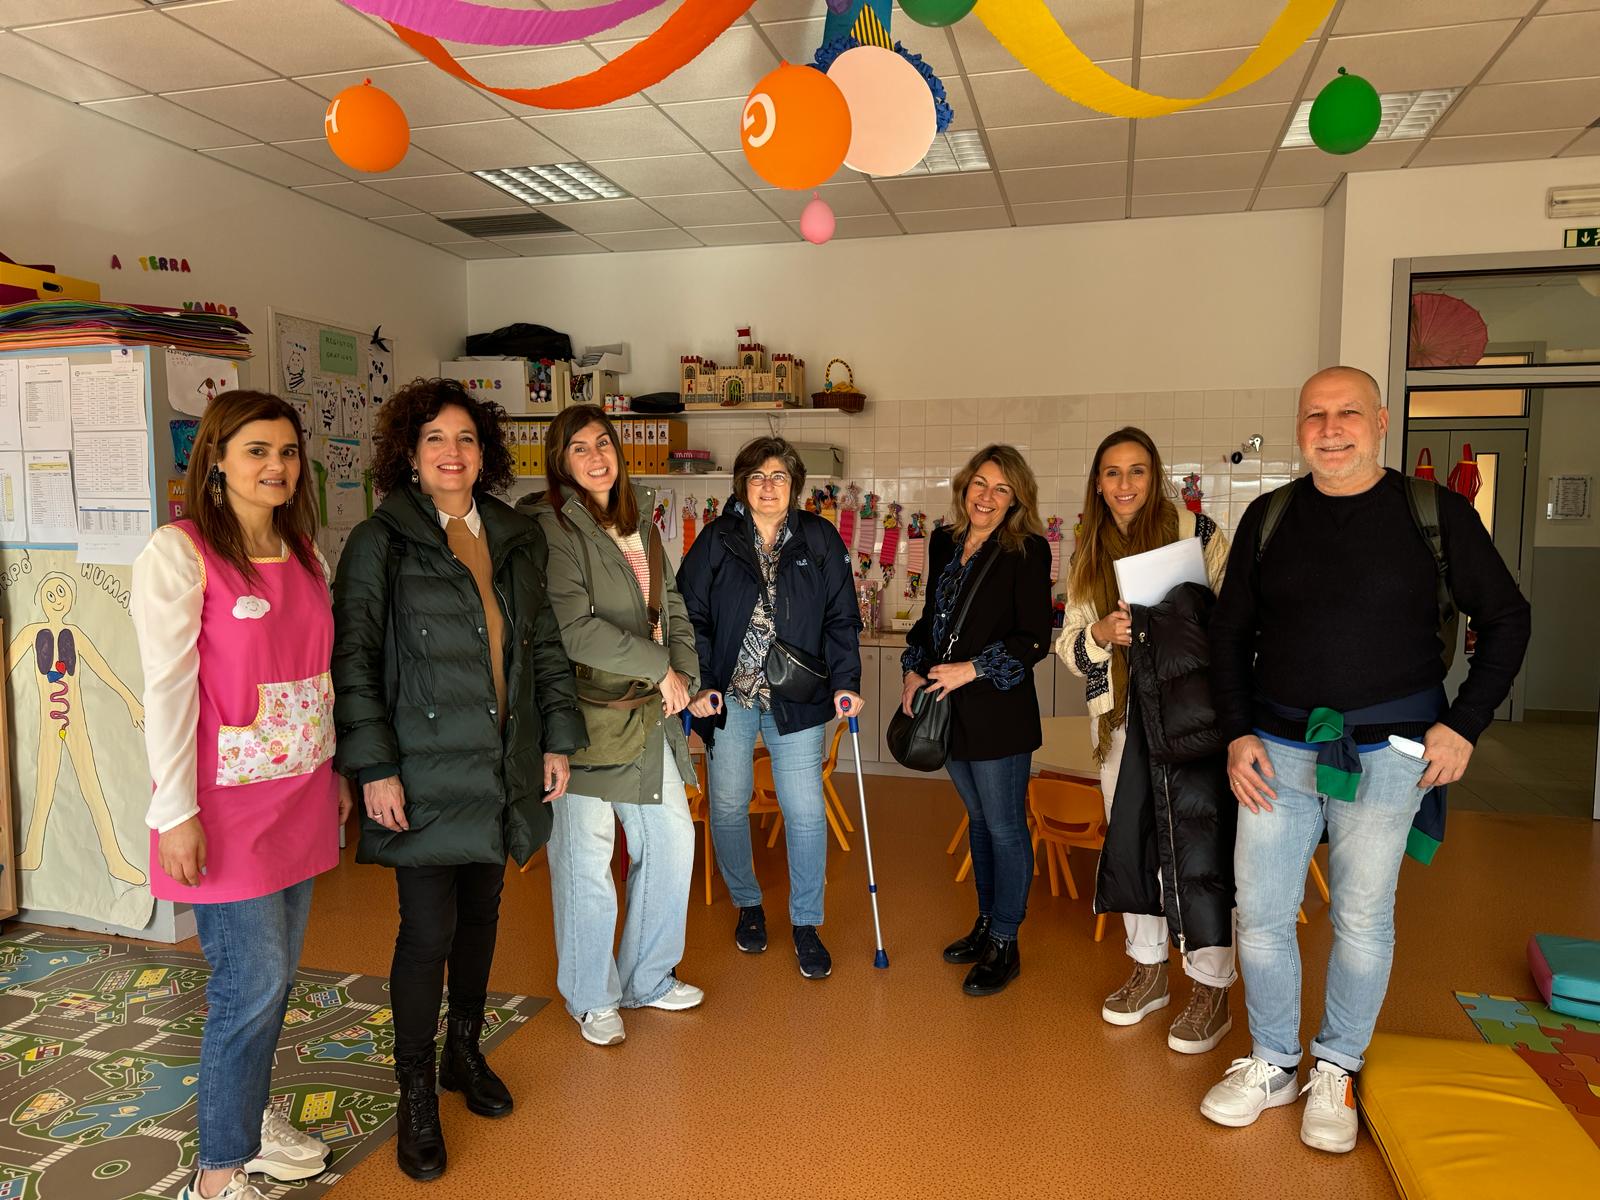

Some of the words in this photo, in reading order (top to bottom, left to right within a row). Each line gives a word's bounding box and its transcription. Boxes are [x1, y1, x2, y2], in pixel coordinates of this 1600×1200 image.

[111, 254, 122, 270] A
[138, 255, 191, 273] TERRA
[183, 301, 238, 319] VAMOS
[462, 378, 503, 391] ASTAS
[0, 557, 33, 591] RPO
[80, 562, 133, 617] HUMA
